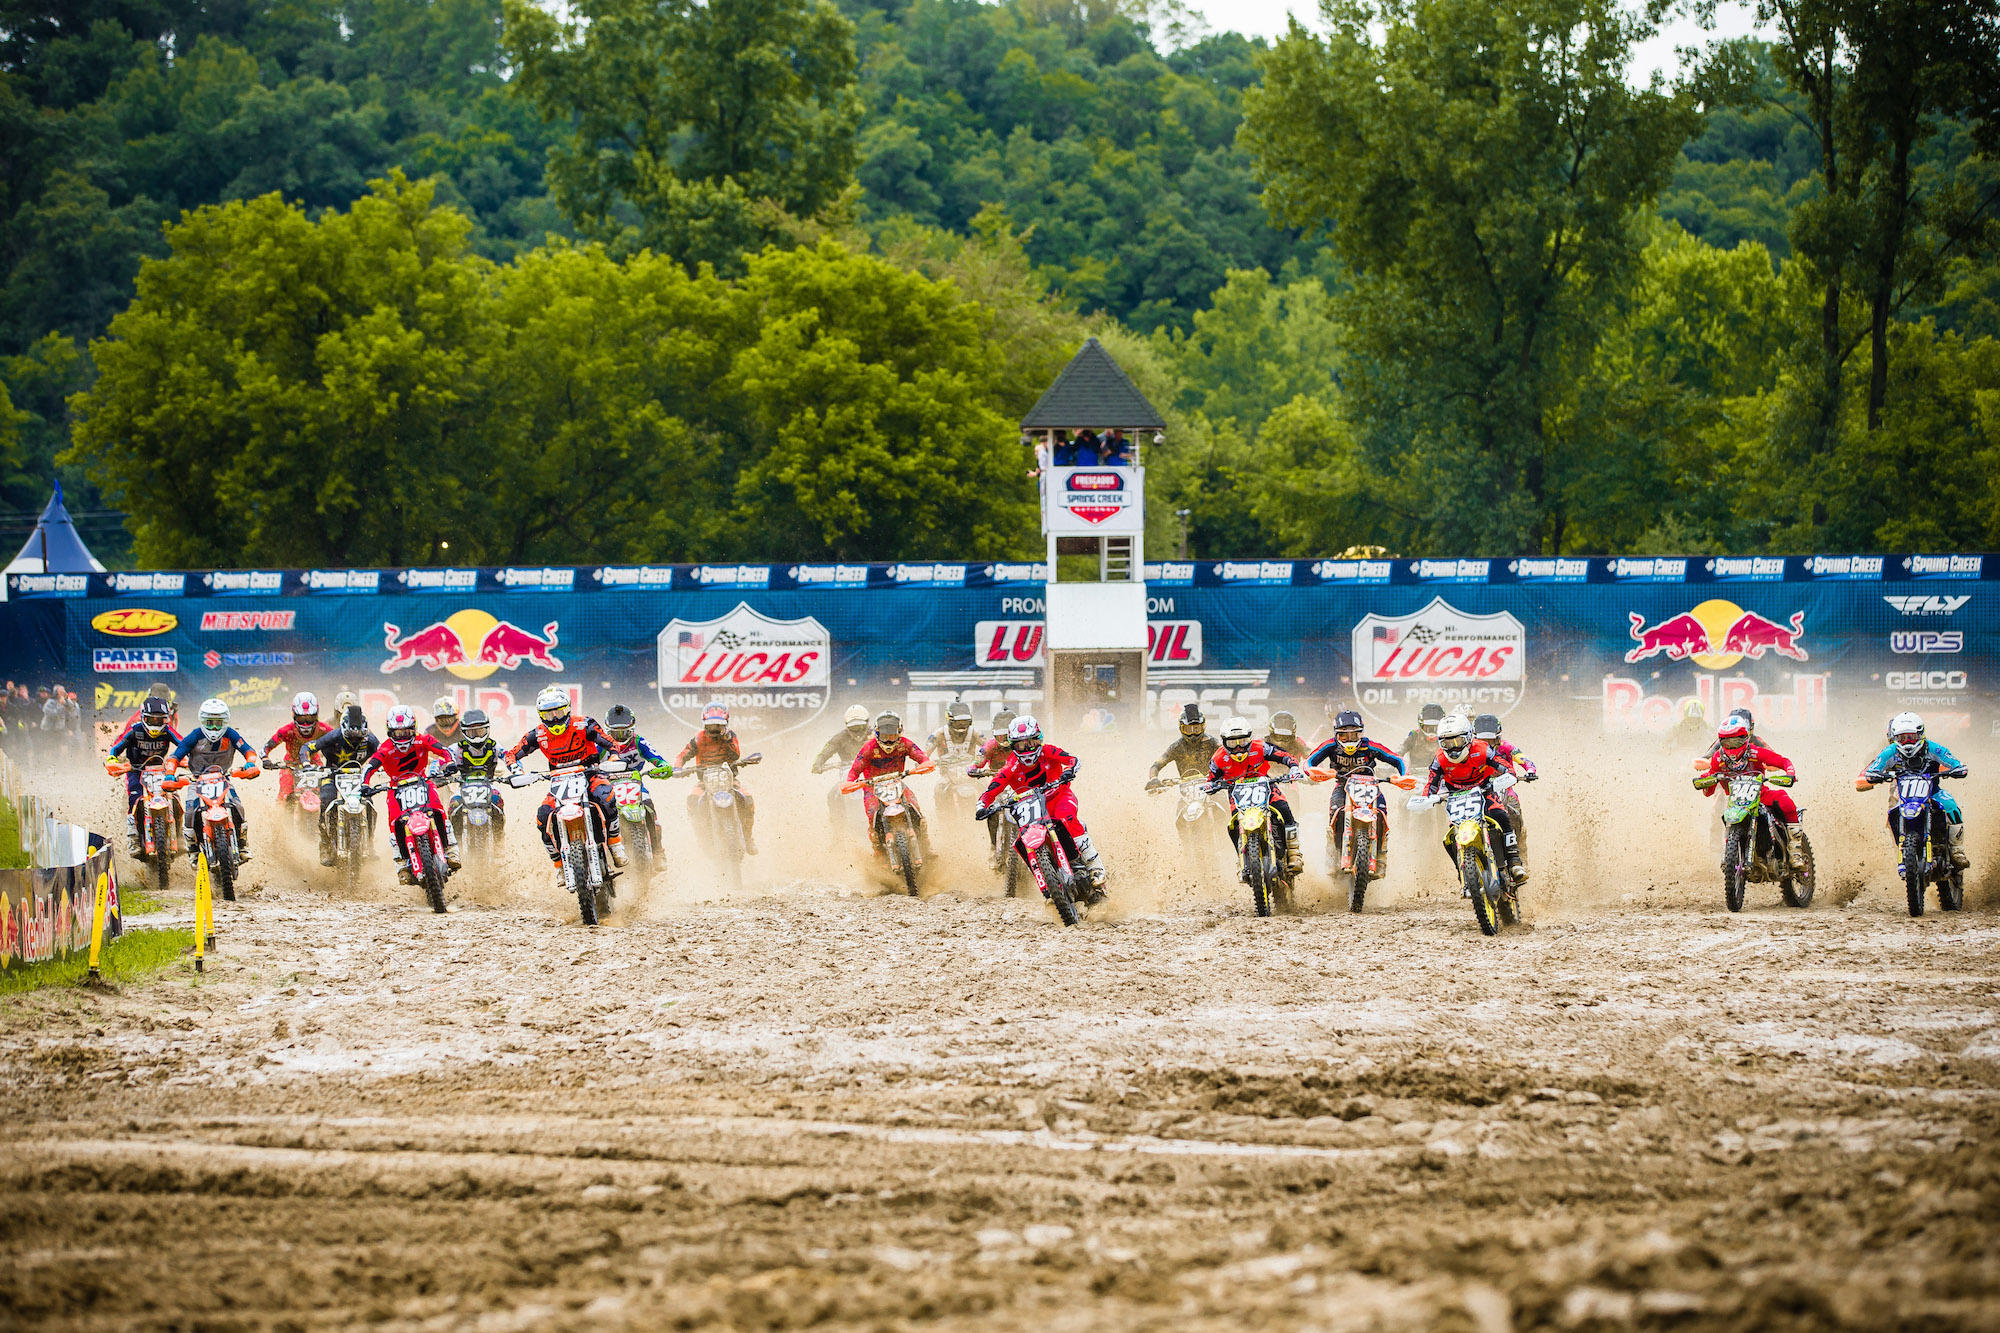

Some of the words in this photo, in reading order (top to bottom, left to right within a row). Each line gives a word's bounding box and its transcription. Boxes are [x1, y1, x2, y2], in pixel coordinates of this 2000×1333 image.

[1617, 559, 1654, 576] SPRING
[1654, 559, 1686, 575] CREEK
[1716, 558, 1753, 575] SPRING
[1753, 558, 1785, 574] CREEK
[1814, 557, 1851, 574] SPRING
[1851, 557, 1883, 573] CREEK
[1912, 556, 1949, 573] SPRING
[1949, 556, 1981, 572] CREEK
[1883, 595, 1972, 611] FLY
[91, 609, 178, 636] FMF
[1891, 631, 1964, 653] WPS
[95, 648, 176, 662] PARTS
[224, 652, 295, 666] SUZUKI
[1374, 646, 1514, 678] LUCAS
[95, 662, 176, 671] UNLIMITED
[680, 651, 819, 683] LUCAS
[1885, 671, 1967, 690] GEICO
[669, 693, 704, 708] OIL
[711, 693, 821, 708] PRODUCTS
[1363, 688, 1398, 704] OIL
[1405, 687, 1516, 704] PRODUCTS
[1896, 696, 1957, 706] MOTORCYCLE
[201, 781, 225, 799] 91
[462, 786, 488, 804] 32
[552, 777, 586, 800] 78
[613, 782, 640, 804] 92
[1239, 786, 1267, 807] 26
[1348, 784, 1378, 803] 123
[1730, 784, 1760, 802] 346
[1900, 780, 1930, 798] 110
[398, 786, 427, 811] 196
[1017, 799, 1041, 827] 31
[1448, 797, 1481, 820] 55
[407, 841, 420, 871] GICO
[1030, 858, 1045, 888] GICO
